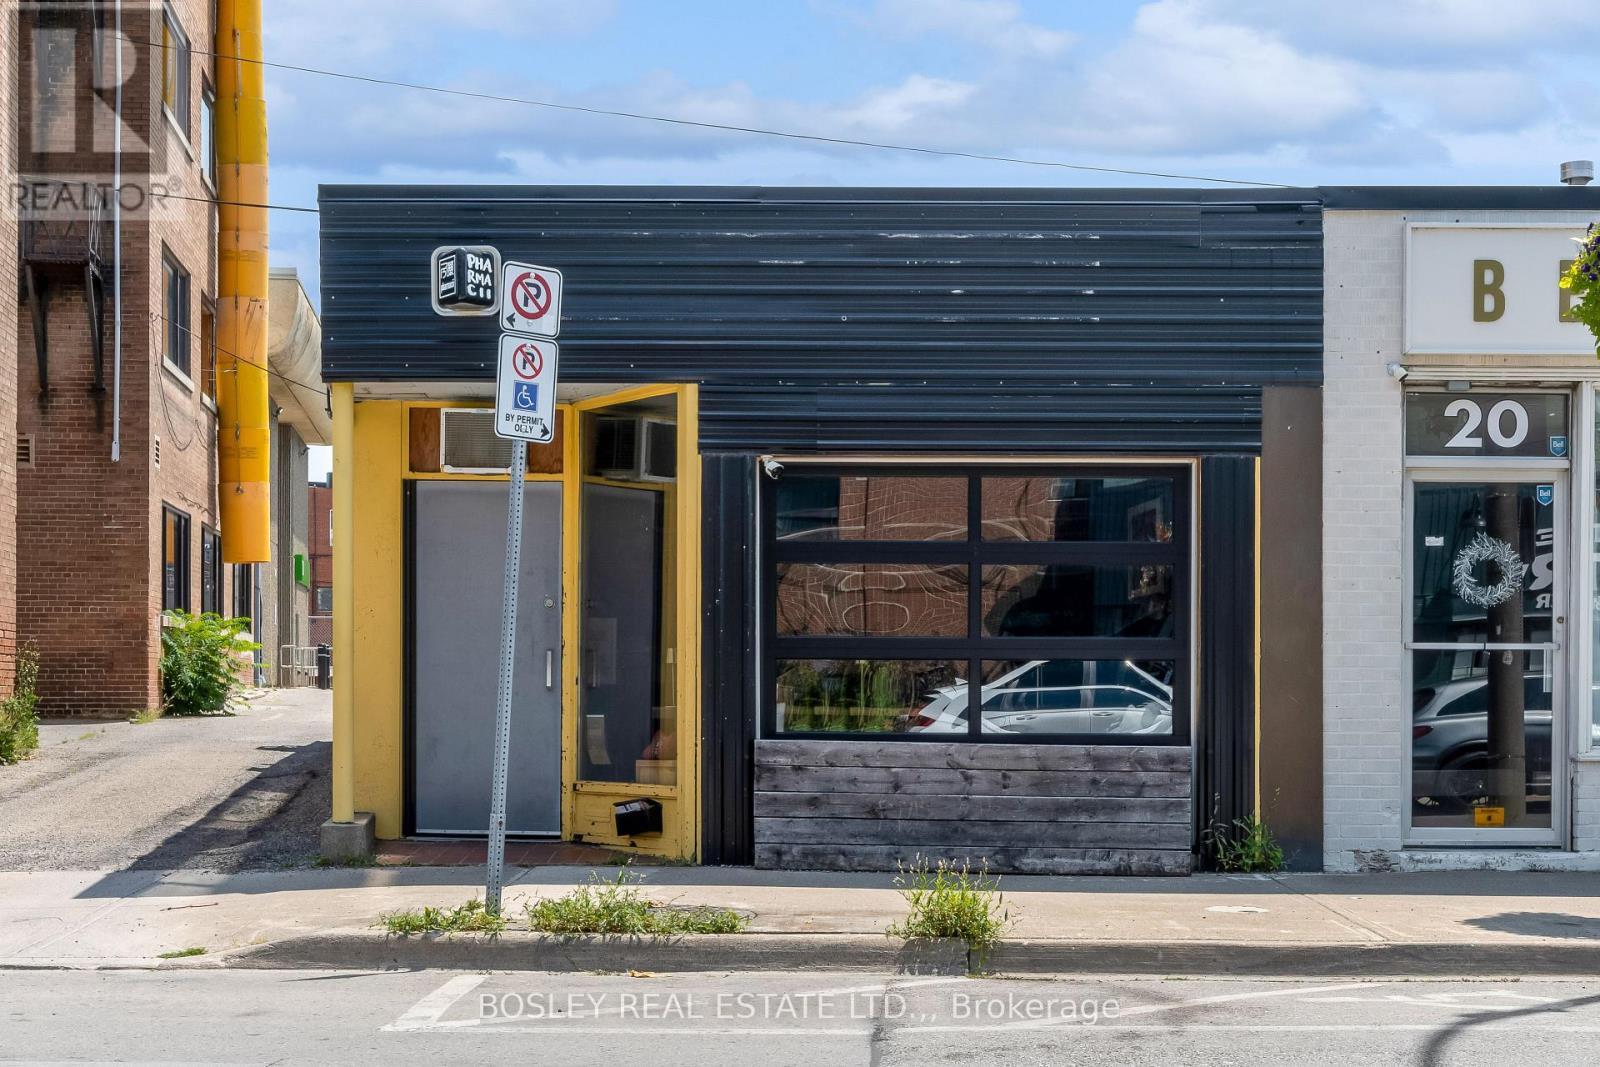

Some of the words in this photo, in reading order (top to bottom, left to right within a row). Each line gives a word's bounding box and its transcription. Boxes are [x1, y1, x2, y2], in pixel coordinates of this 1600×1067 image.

[466, 253, 493, 273] PHA
[467, 269, 492, 287] RMA
[505, 413, 515, 423] BY
[516, 414, 544, 426] PERMIT
[1443, 399, 1529, 448] 20
[1552, 440, 1565, 448] Bell
[1539, 489, 1551, 497] Bell
